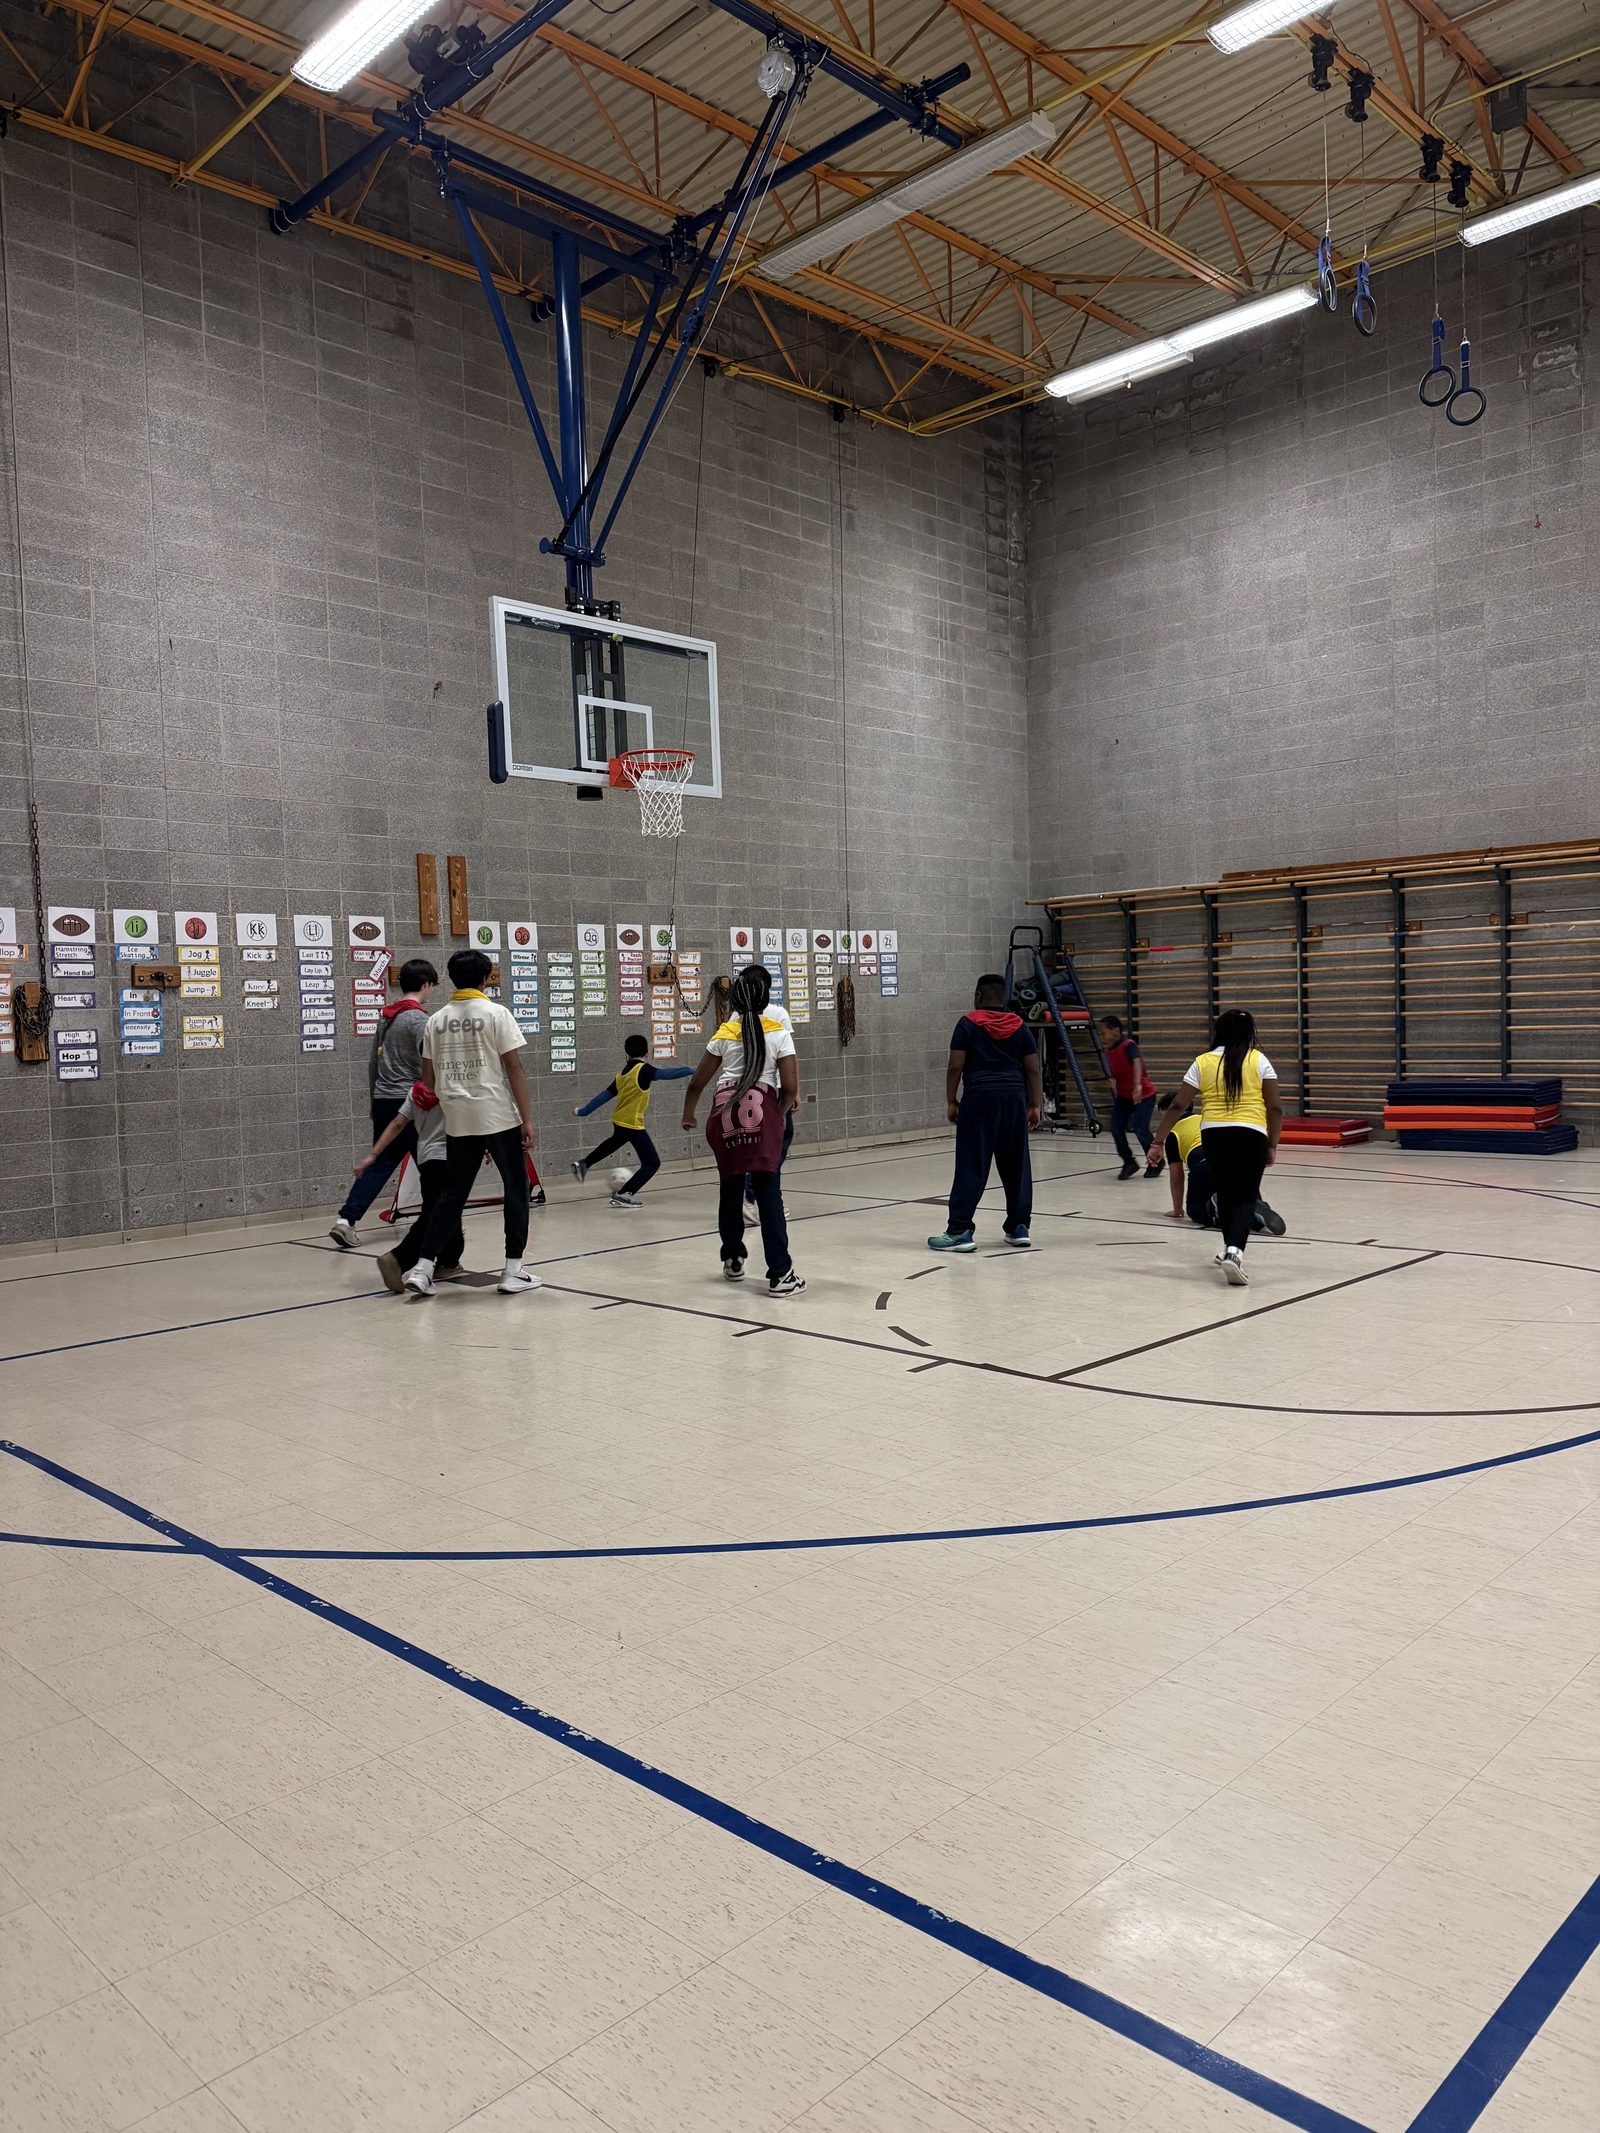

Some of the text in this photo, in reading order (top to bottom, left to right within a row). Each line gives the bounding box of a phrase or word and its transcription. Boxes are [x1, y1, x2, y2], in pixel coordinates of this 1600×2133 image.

[188, 950, 202, 959] Jog
[246, 951, 262, 959] Kick
[192, 968, 217, 978] Juggle
[373, 959, 387, 979] March
[305, 981, 320, 989] Leap
[185, 985, 206, 995] Jump
[124, 1009, 151, 1017] In Front
[435, 1015, 485, 1035] Jeep
[62, 1053, 80, 1061] Hop
[445, 1070, 479, 1081] vines
